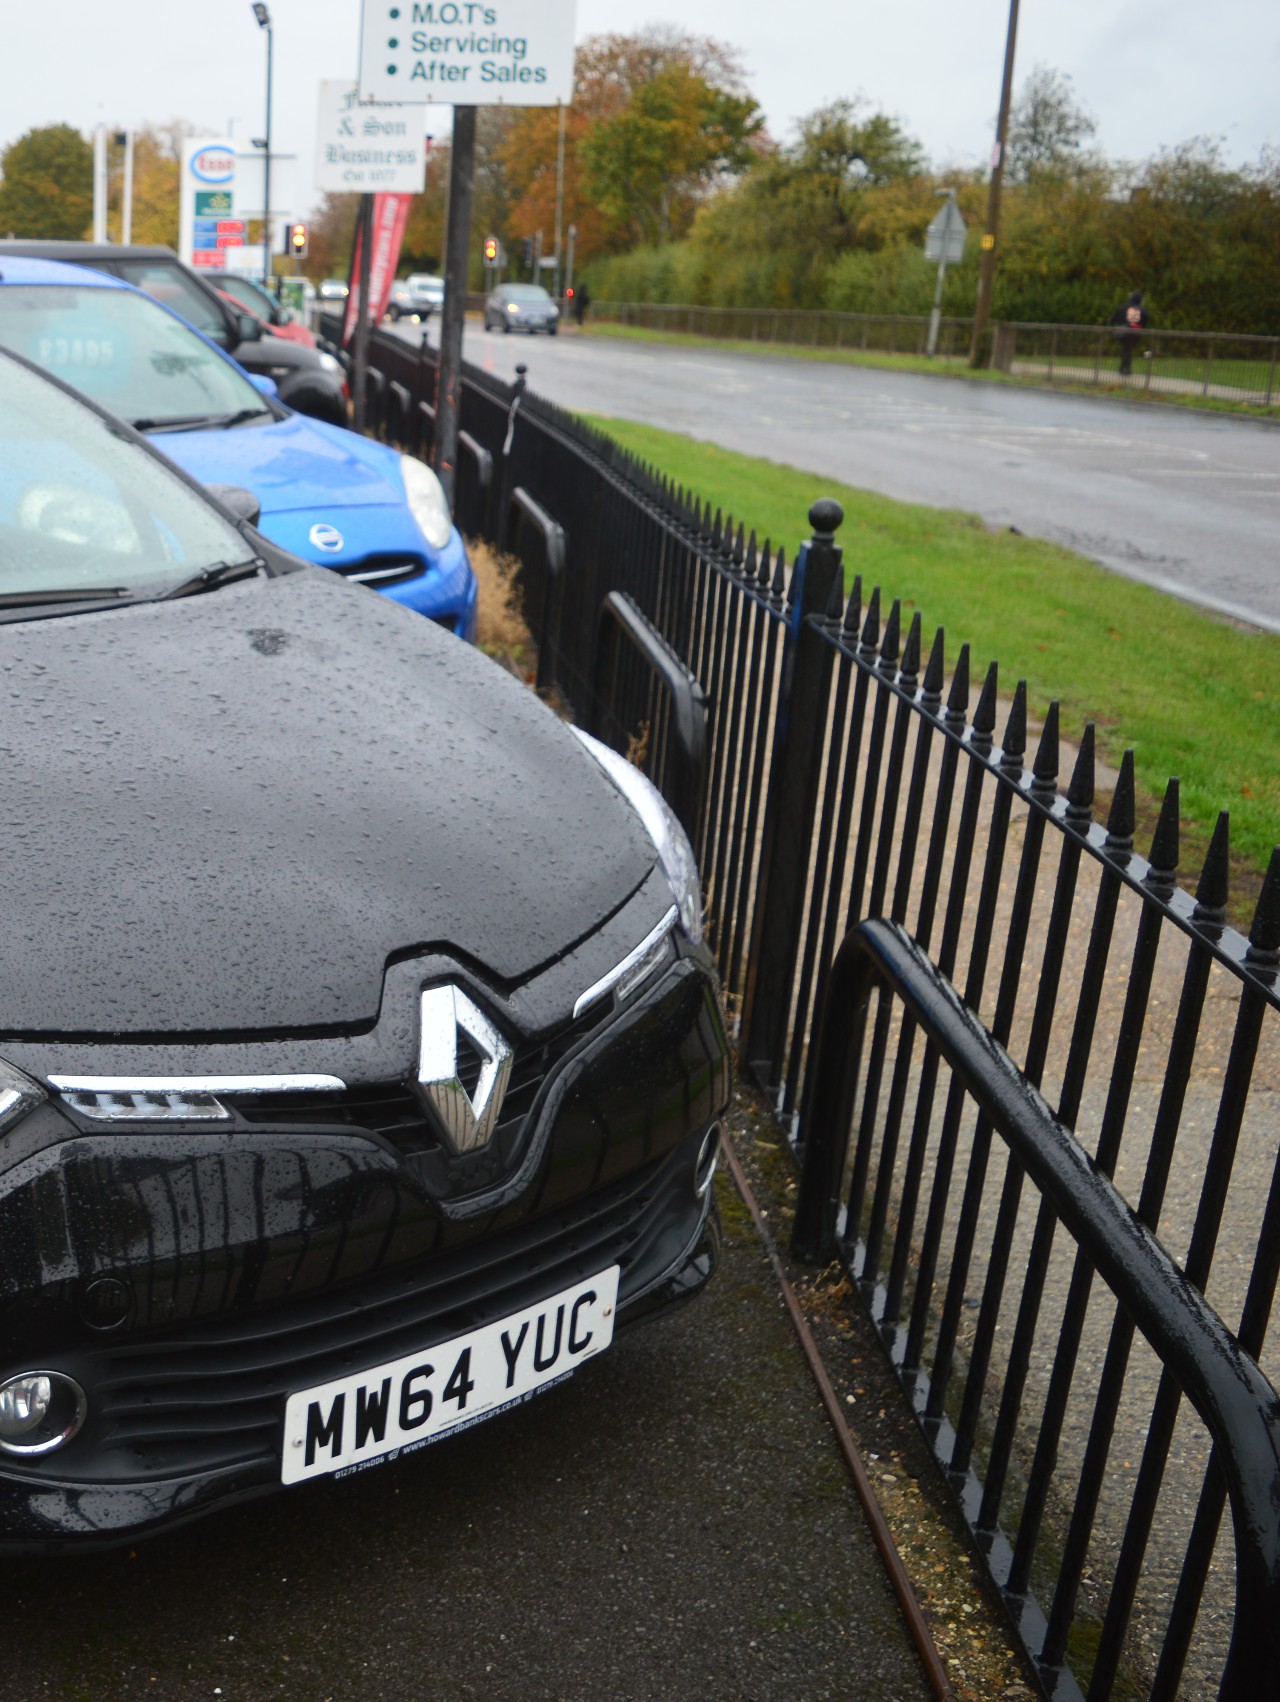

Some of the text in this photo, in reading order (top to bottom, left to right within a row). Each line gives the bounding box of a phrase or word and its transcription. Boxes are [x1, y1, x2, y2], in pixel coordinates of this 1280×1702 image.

[412, 4, 496, 24] M.O.T's
[412, 31, 527, 58] Servicing
[410, 61, 547, 83] After Sales
[362, 116, 407, 136] Son
[304, 1290, 597, 1467] MW64 YUC
[402, 1394, 523, 1454] www.howardbankscars.co.uk
